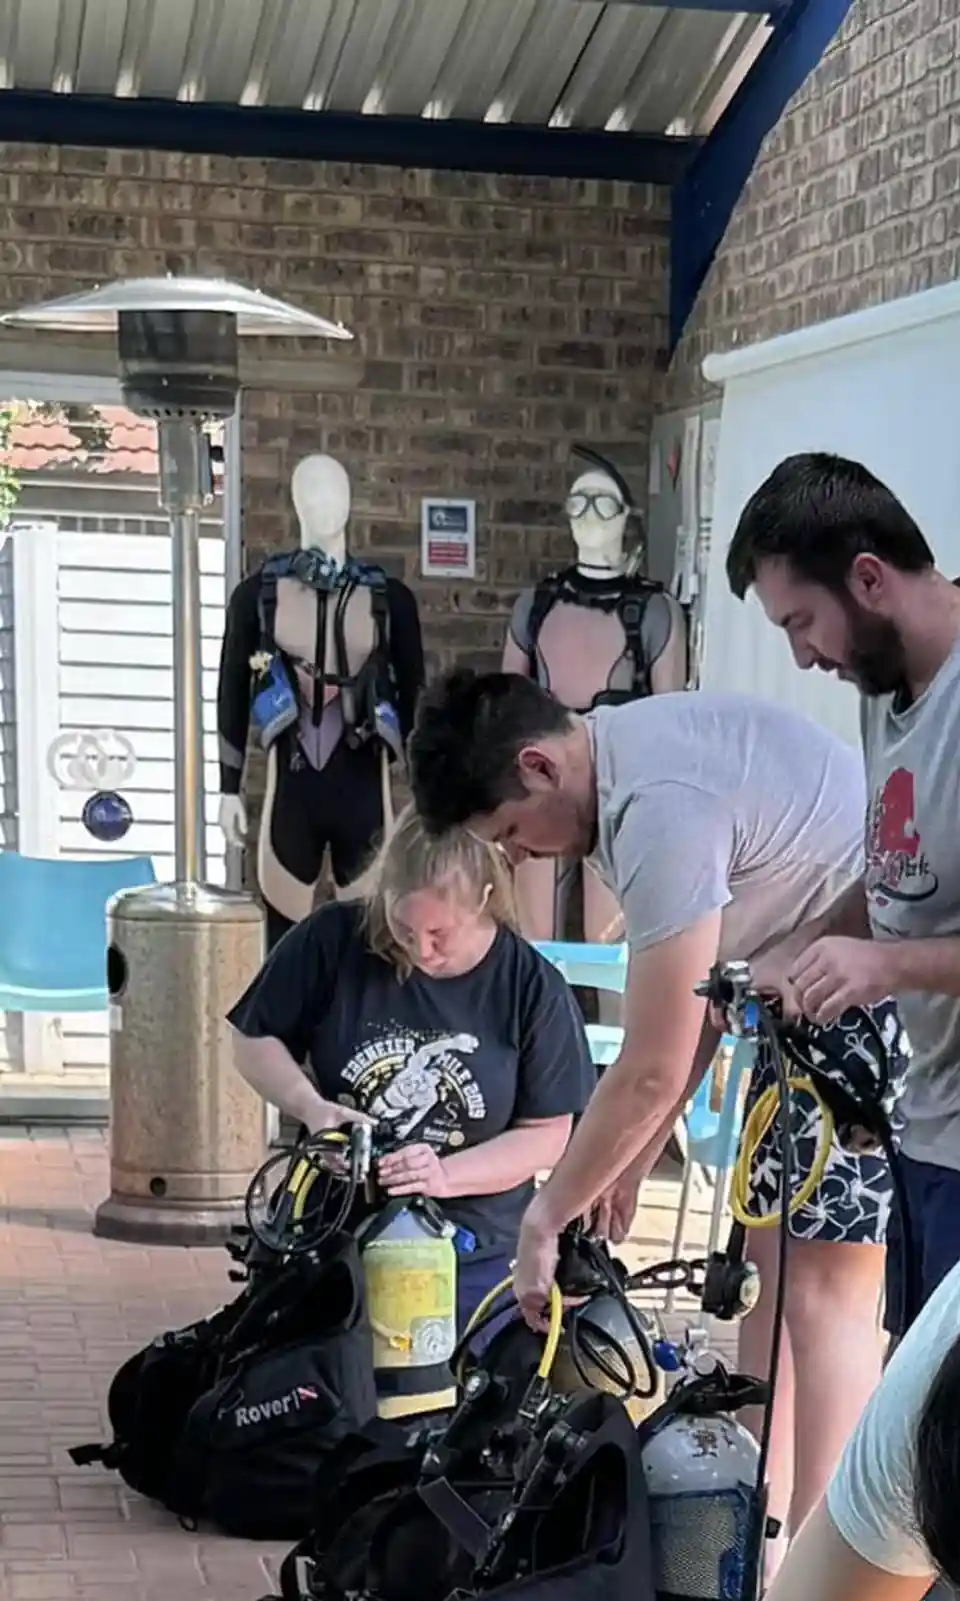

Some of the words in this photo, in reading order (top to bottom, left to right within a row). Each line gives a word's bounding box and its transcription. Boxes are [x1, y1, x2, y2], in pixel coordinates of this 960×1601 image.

[340, 1037, 416, 1084] EBENEZER
[463, 1081, 487, 1119] 2019
[235, 1395, 292, 1427] Rover
